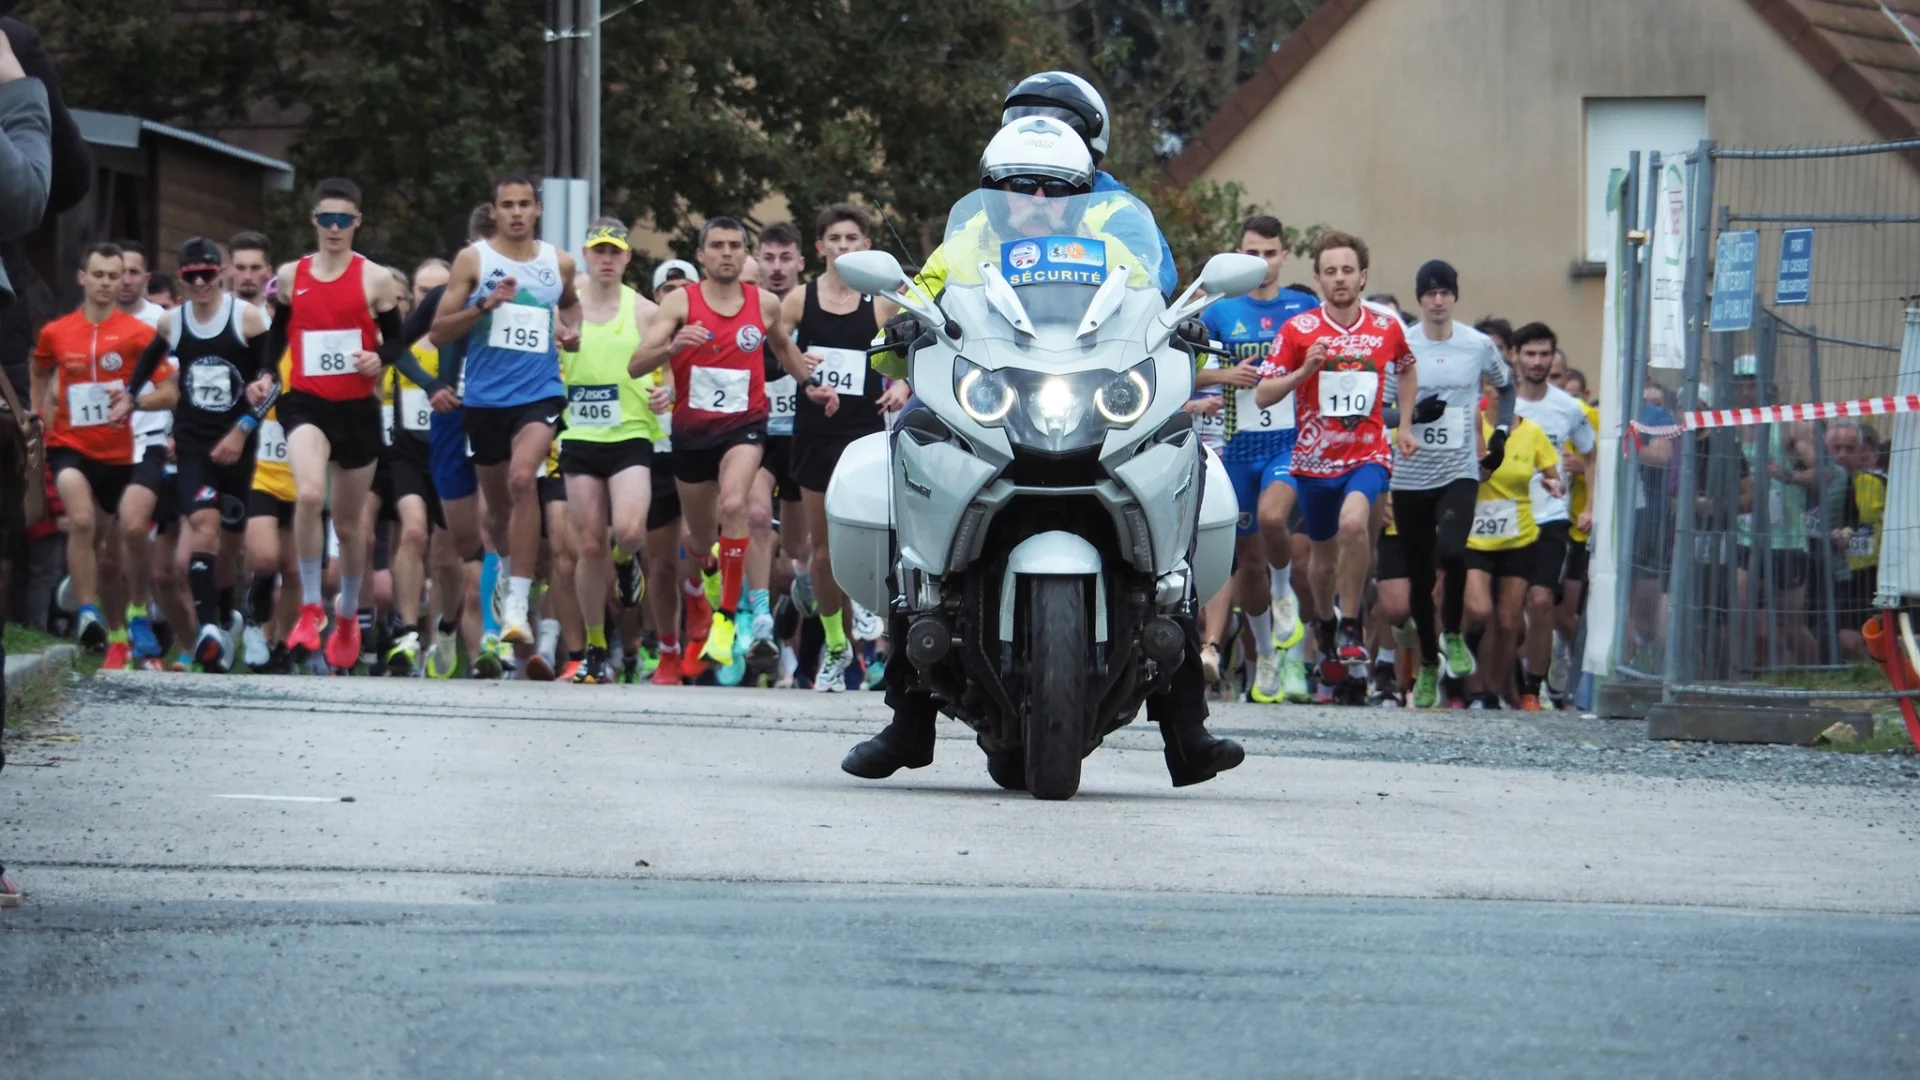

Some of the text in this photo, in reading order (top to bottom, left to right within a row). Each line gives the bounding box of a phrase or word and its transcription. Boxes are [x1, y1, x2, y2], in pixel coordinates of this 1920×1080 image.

[1010, 270, 1101, 284] SÉCURITÉ
[503, 327, 539, 348] 195
[320, 352, 346, 371] 88
[816, 370, 852, 389] 194
[199, 386, 225, 401] 72
[713, 390, 726, 408] 2
[579, 404, 611, 419] 406
[768, 394, 796, 413] 158
[1329, 394, 1366, 412] 110
[81, 403, 113, 422] 11
[1260, 410, 1272, 427] 3
[1423, 427, 1448, 445] 65
[1475, 518, 1508, 535] 297
